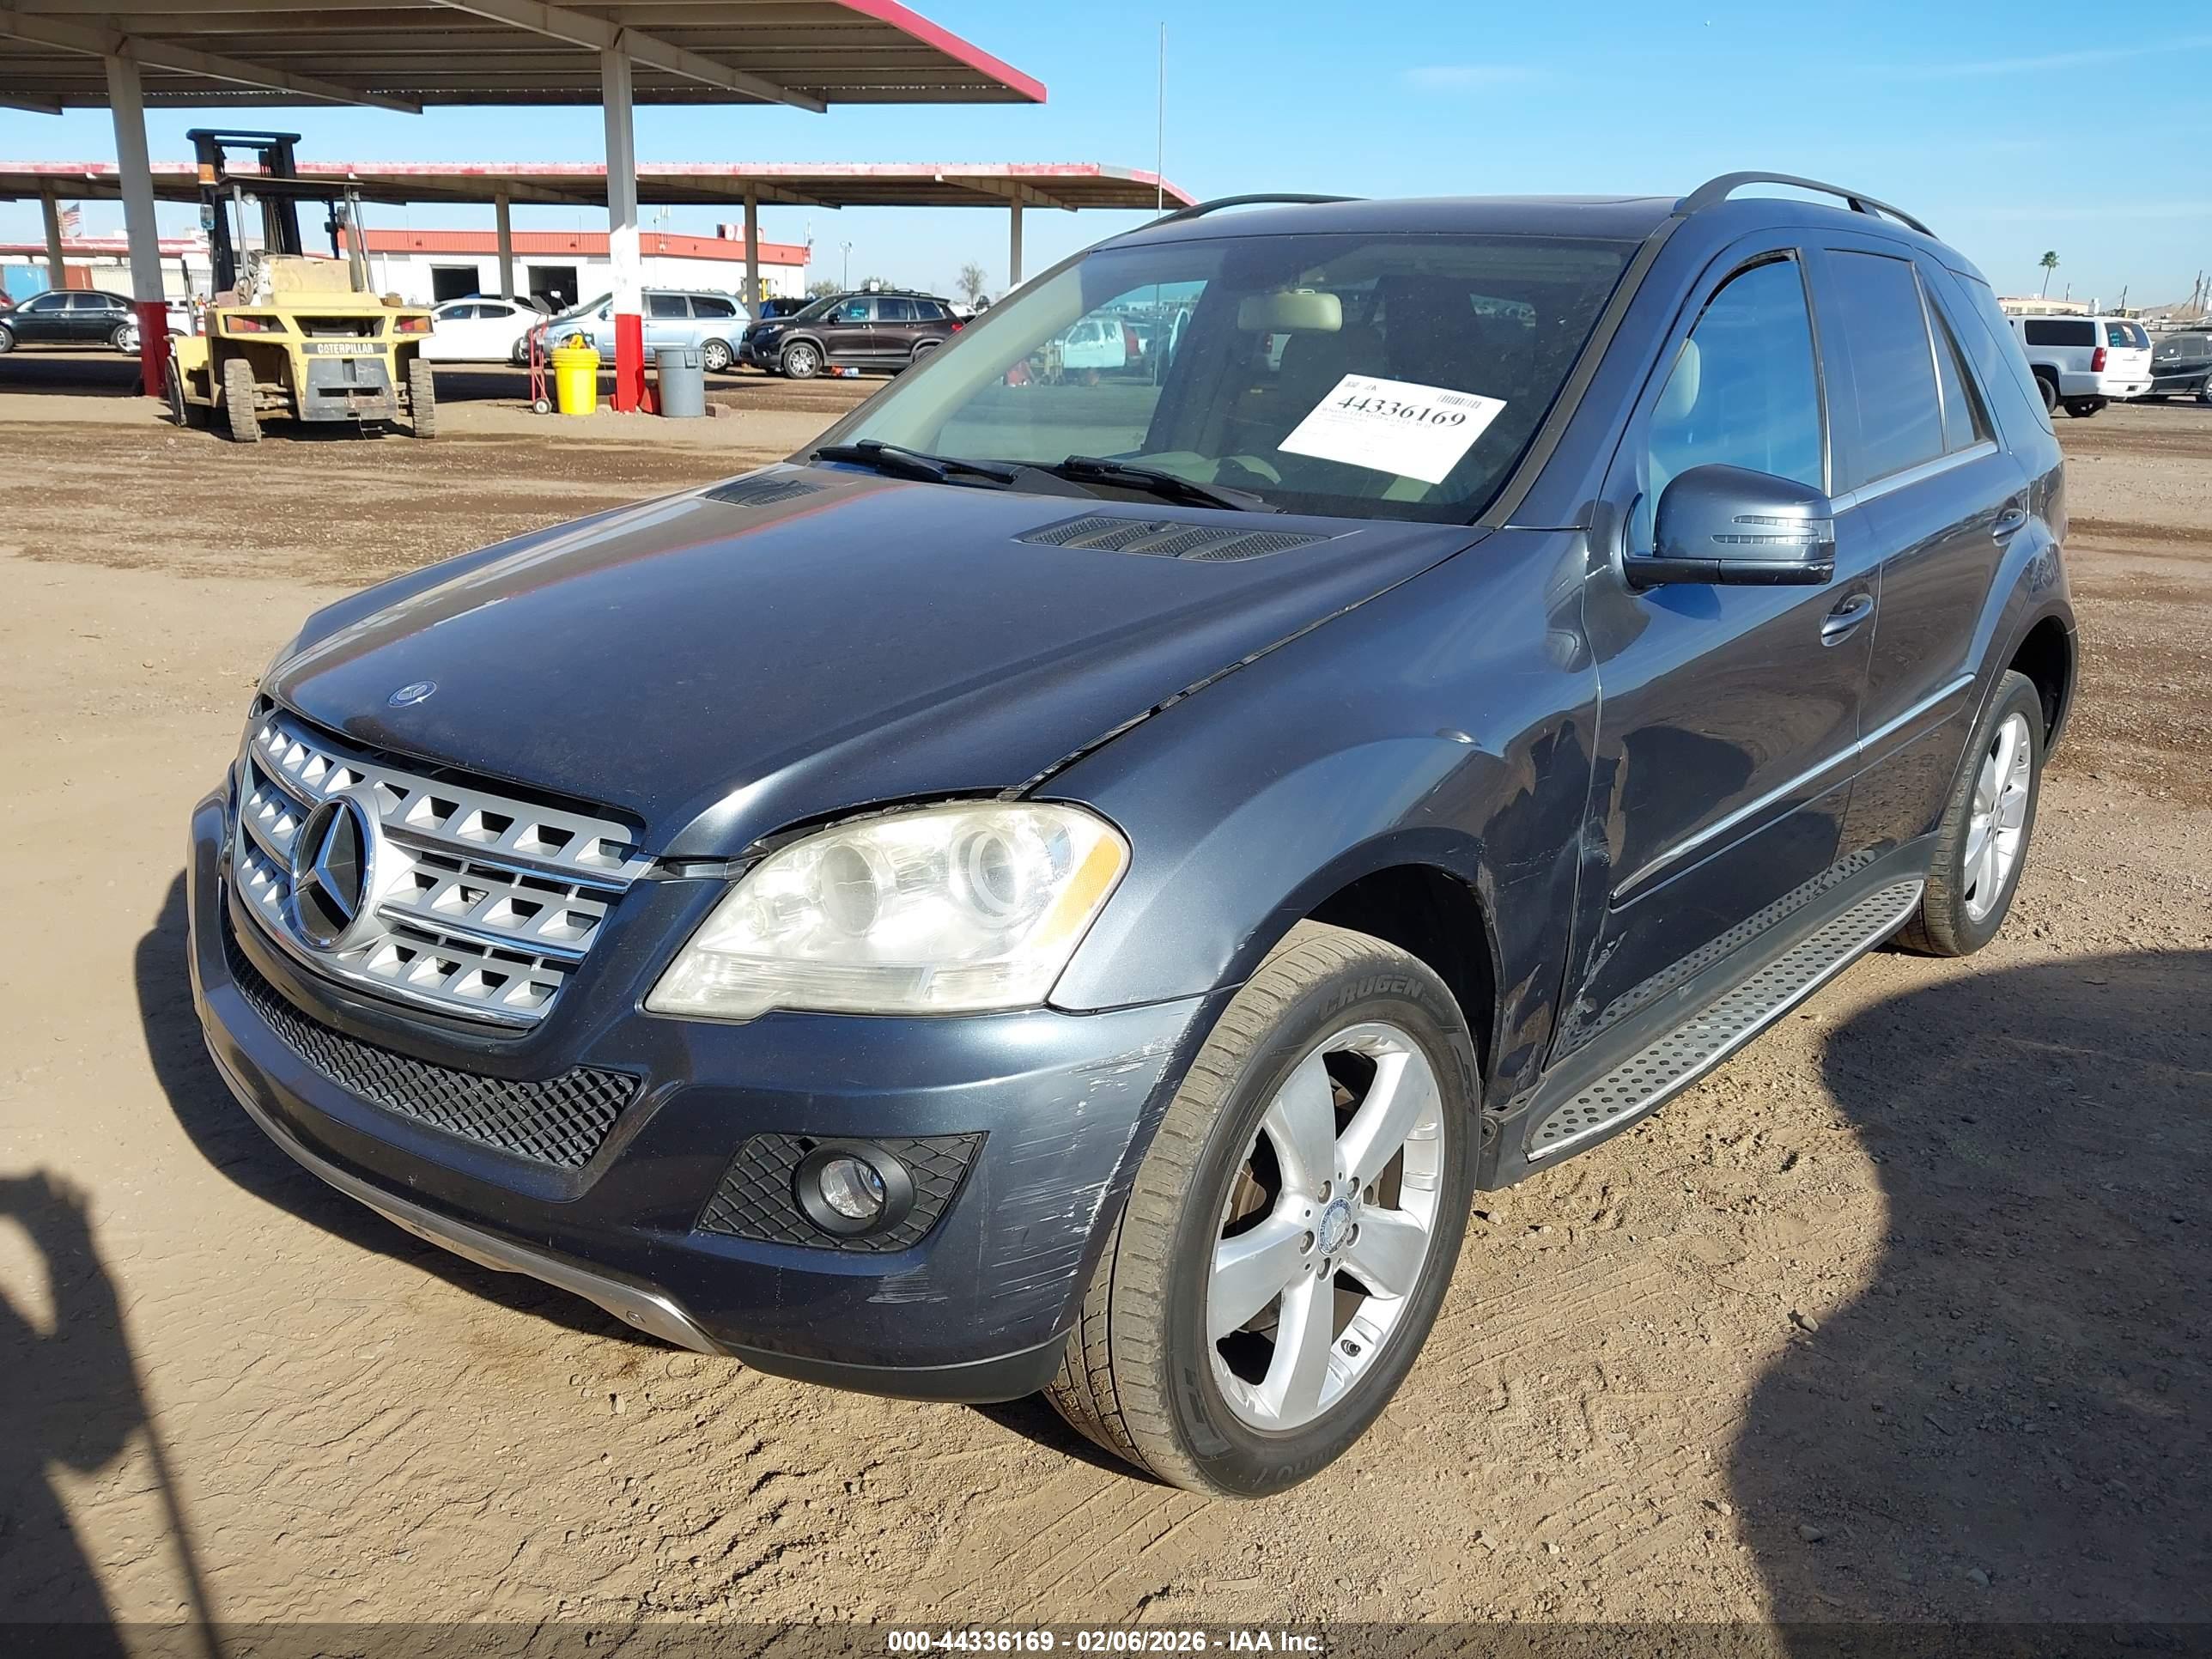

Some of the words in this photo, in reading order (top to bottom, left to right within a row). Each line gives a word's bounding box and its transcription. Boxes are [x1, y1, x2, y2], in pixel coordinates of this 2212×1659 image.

[317, 343, 374, 355] CATERPILLAR
[1337, 395, 1467, 427] 44336169
[1319, 974, 1424, 1020] CRUGEN
